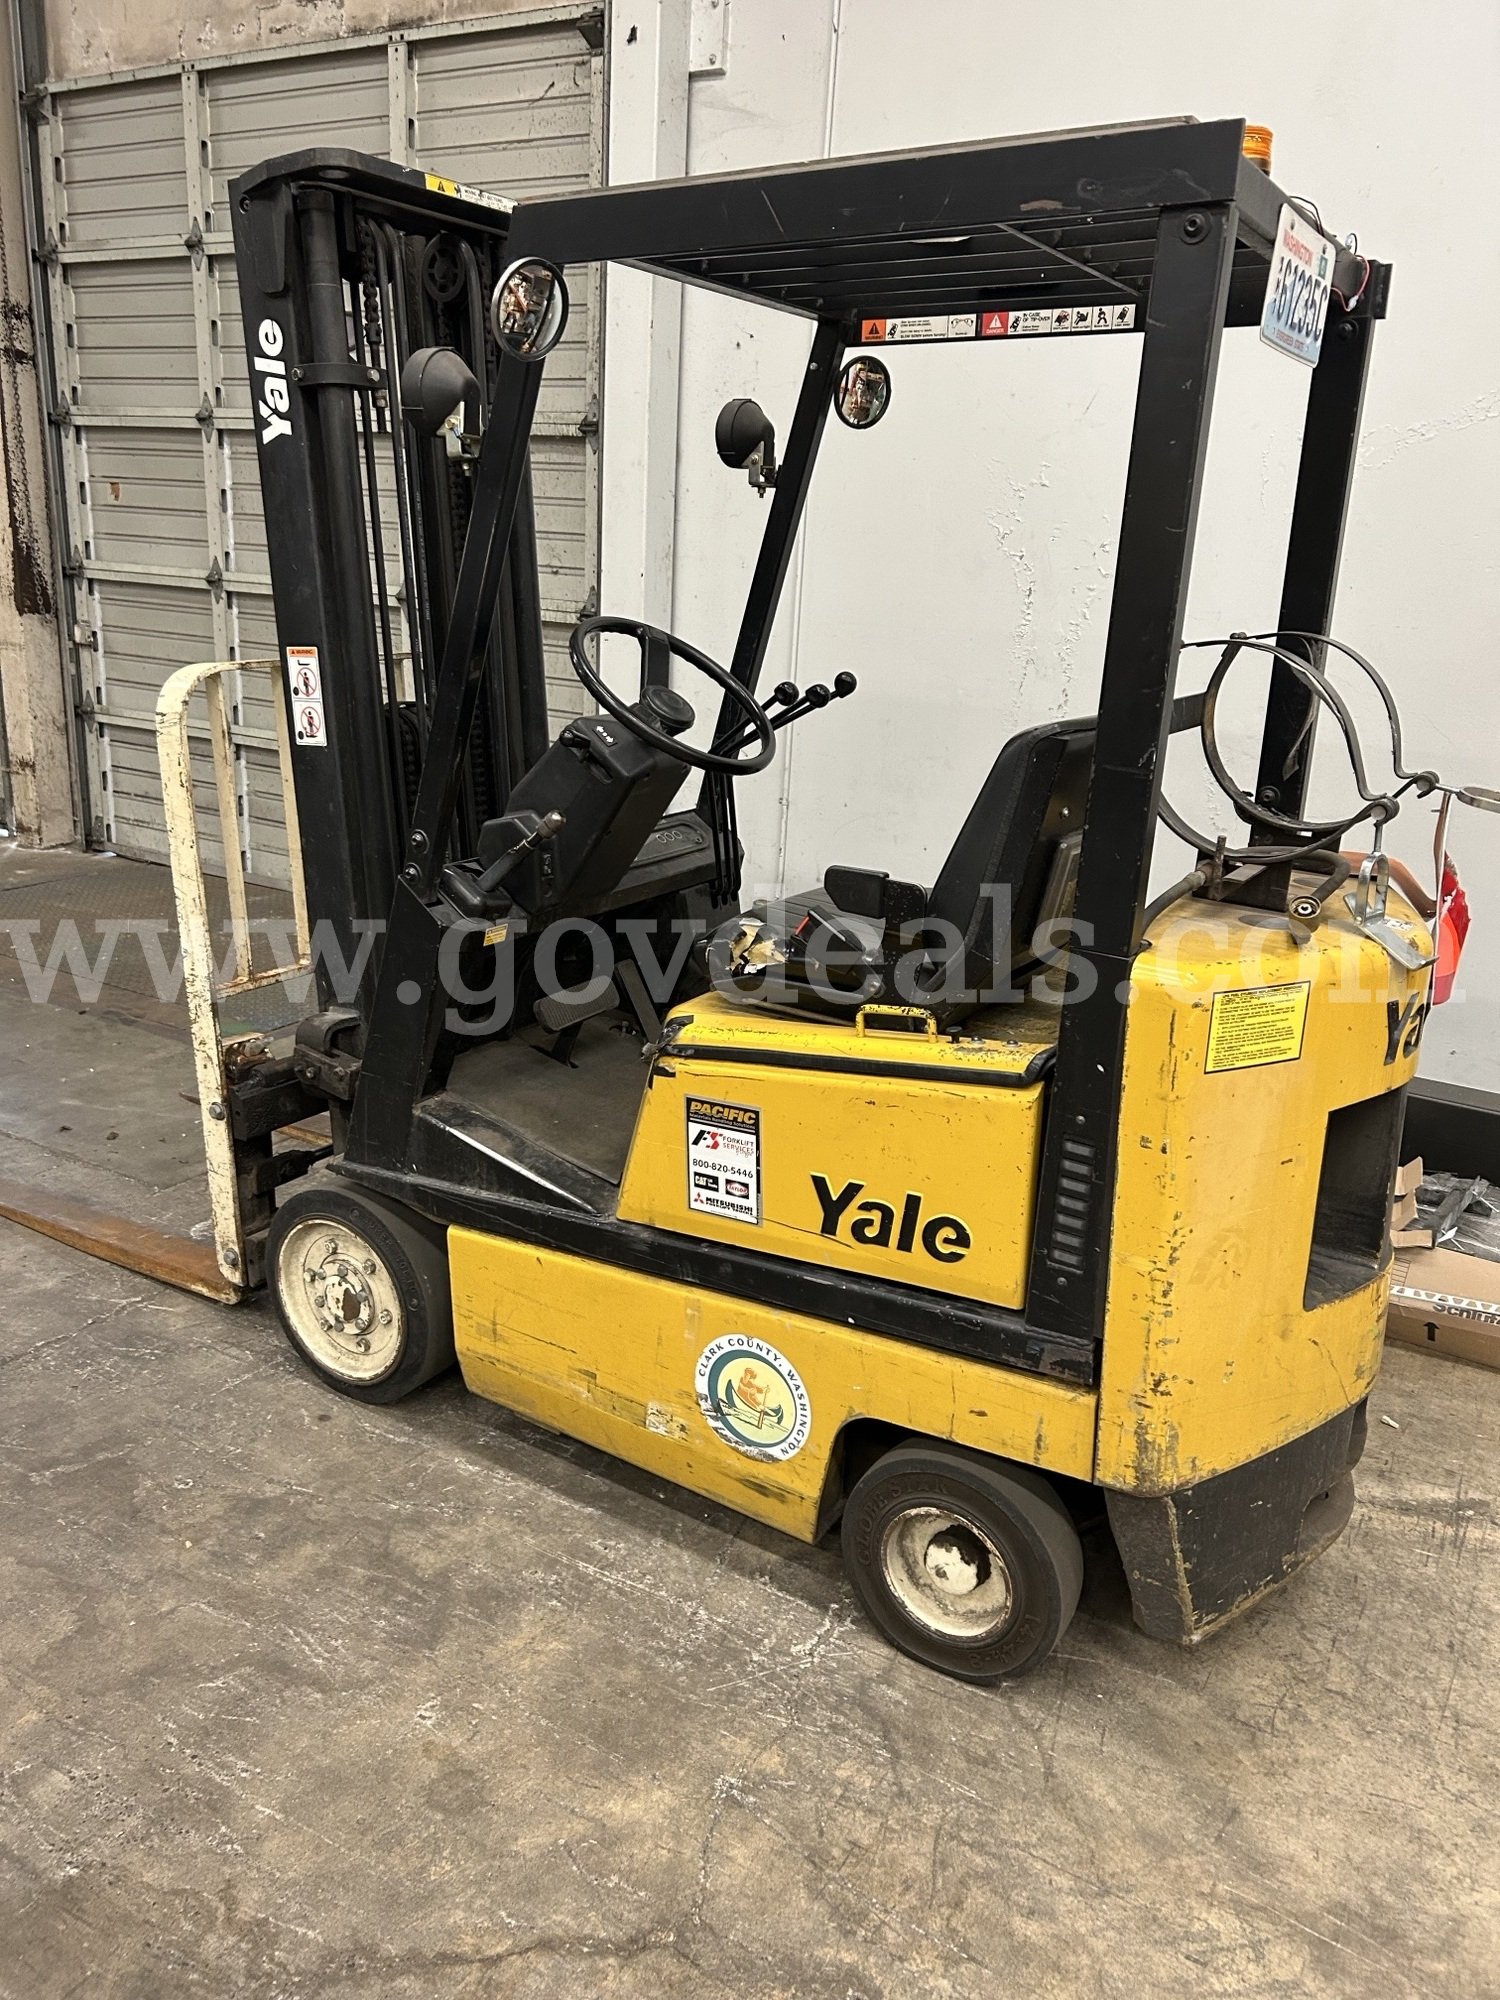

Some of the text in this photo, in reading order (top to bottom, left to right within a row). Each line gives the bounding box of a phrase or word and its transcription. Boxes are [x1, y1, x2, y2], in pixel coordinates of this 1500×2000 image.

[254, 319, 292, 445] Yale
[690, 1101, 756, 1124] PACIFIC
[722, 1135, 754, 1147] FORKLIFT
[692, 1158, 754, 1179] 800-820-5446
[705, 1196, 753, 1213] MITSUBISHI
[810, 1173, 971, 1263] Yale
[698, 1342, 725, 1377] CLARK
[781, 1369, 808, 1456] WASHINGTON
